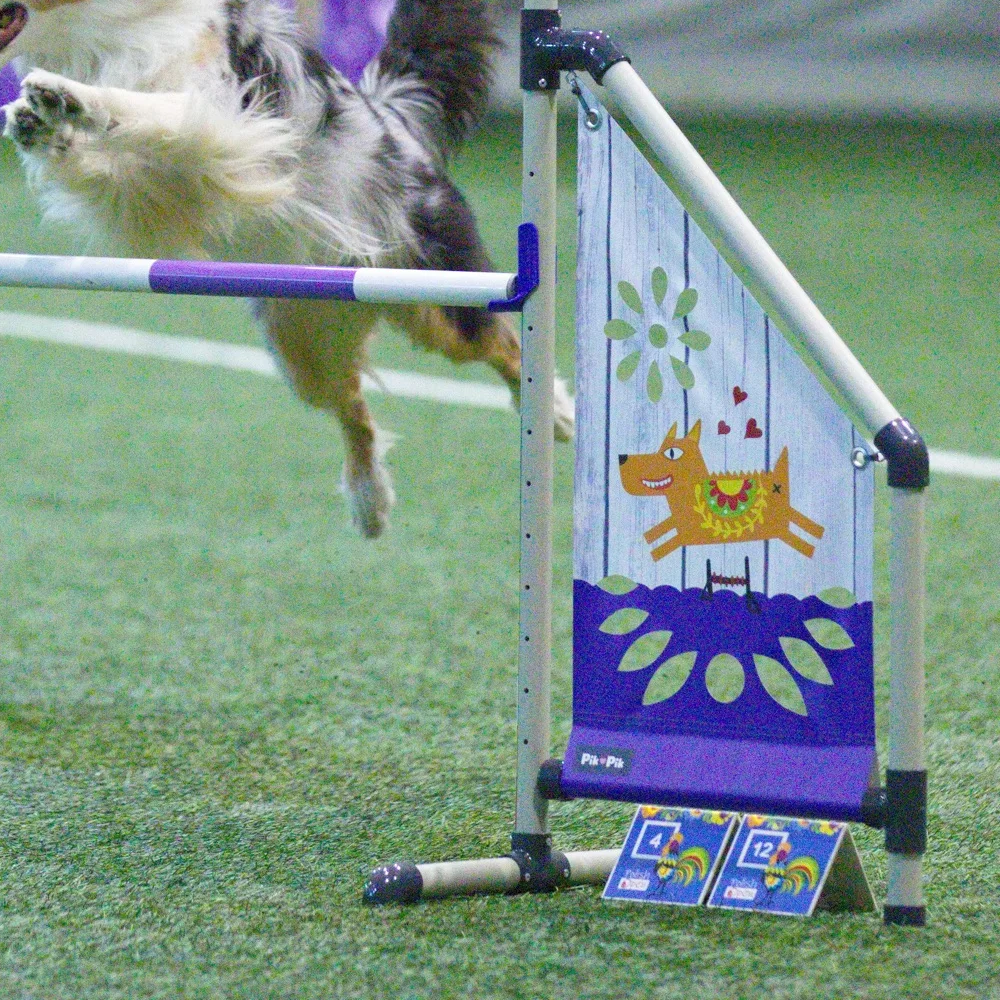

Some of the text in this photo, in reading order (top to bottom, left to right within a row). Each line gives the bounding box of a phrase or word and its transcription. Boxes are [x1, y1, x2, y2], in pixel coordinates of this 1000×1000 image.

[581, 753, 624, 768] Pik Pik
[649, 832, 663, 849] 4
[754, 841, 774, 858] 12
